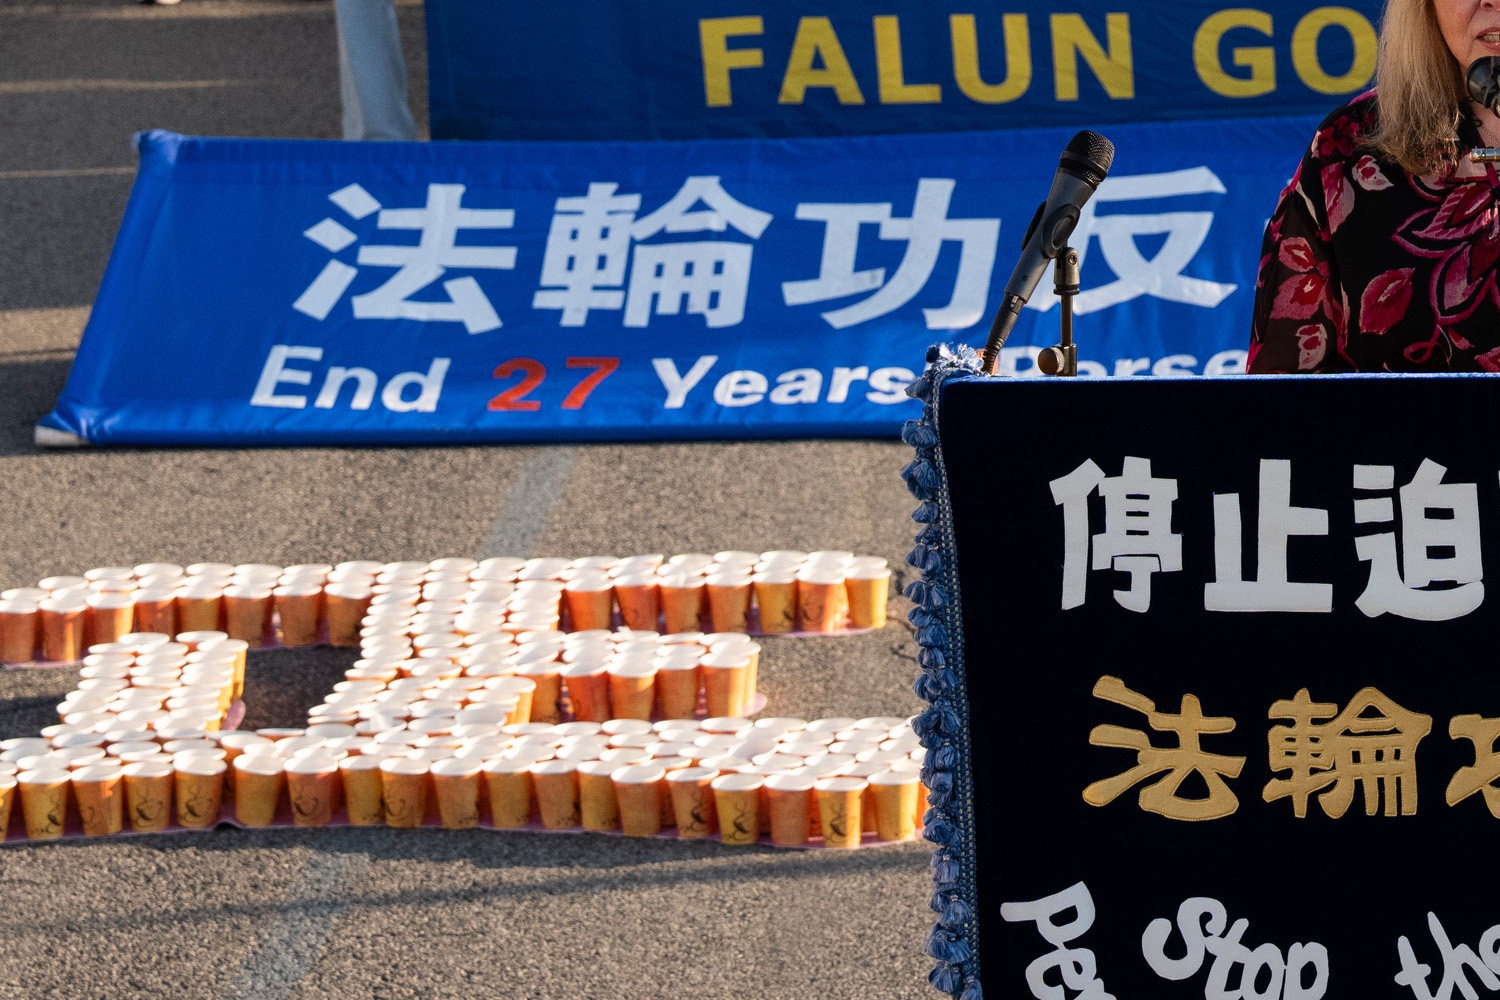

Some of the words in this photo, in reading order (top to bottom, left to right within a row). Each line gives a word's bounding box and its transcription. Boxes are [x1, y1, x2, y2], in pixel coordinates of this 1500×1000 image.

[700, 12, 1134, 106] FALUN
[1193, 7, 1379, 98] GO
[250, 345, 451, 412] End
[489, 357, 619, 411] 27
[652, 355, 912, 409] Years
[1141, 896, 1330, 1000] Stop
